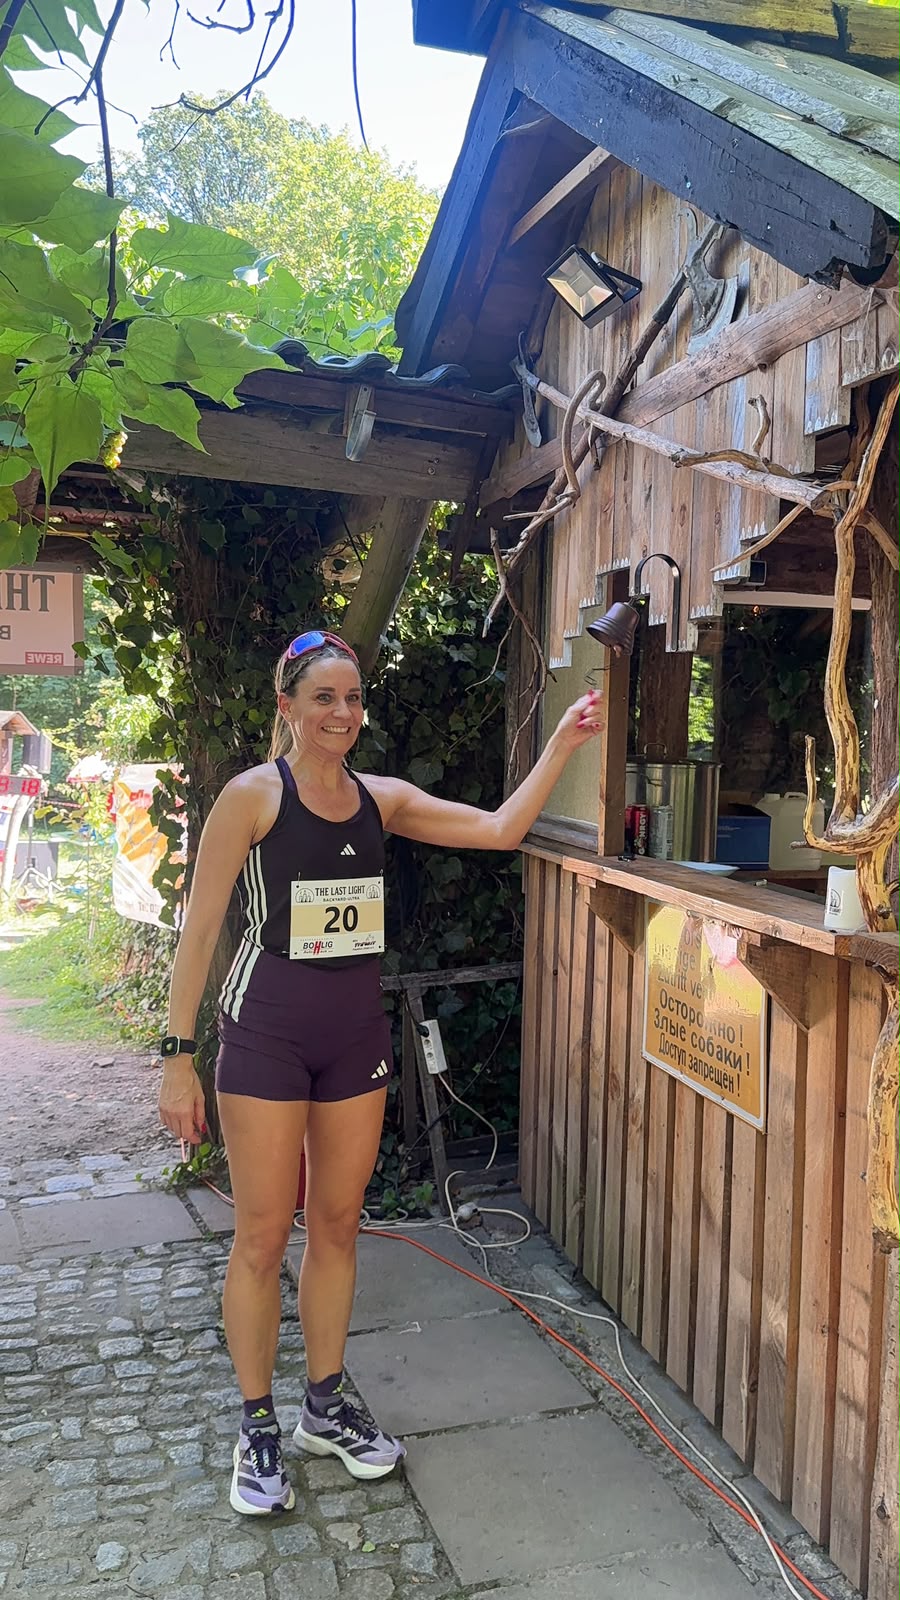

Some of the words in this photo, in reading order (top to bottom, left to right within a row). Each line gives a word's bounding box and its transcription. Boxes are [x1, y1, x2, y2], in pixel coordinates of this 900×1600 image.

[315, 887, 329, 896] THE
[330, 886, 347, 896] LAST
[348, 885, 365, 895] LIGHT
[324, 905, 358, 933] 20
[654, 1008, 686, 1041] Злые
[659, 1033, 686, 1066] Доступ
